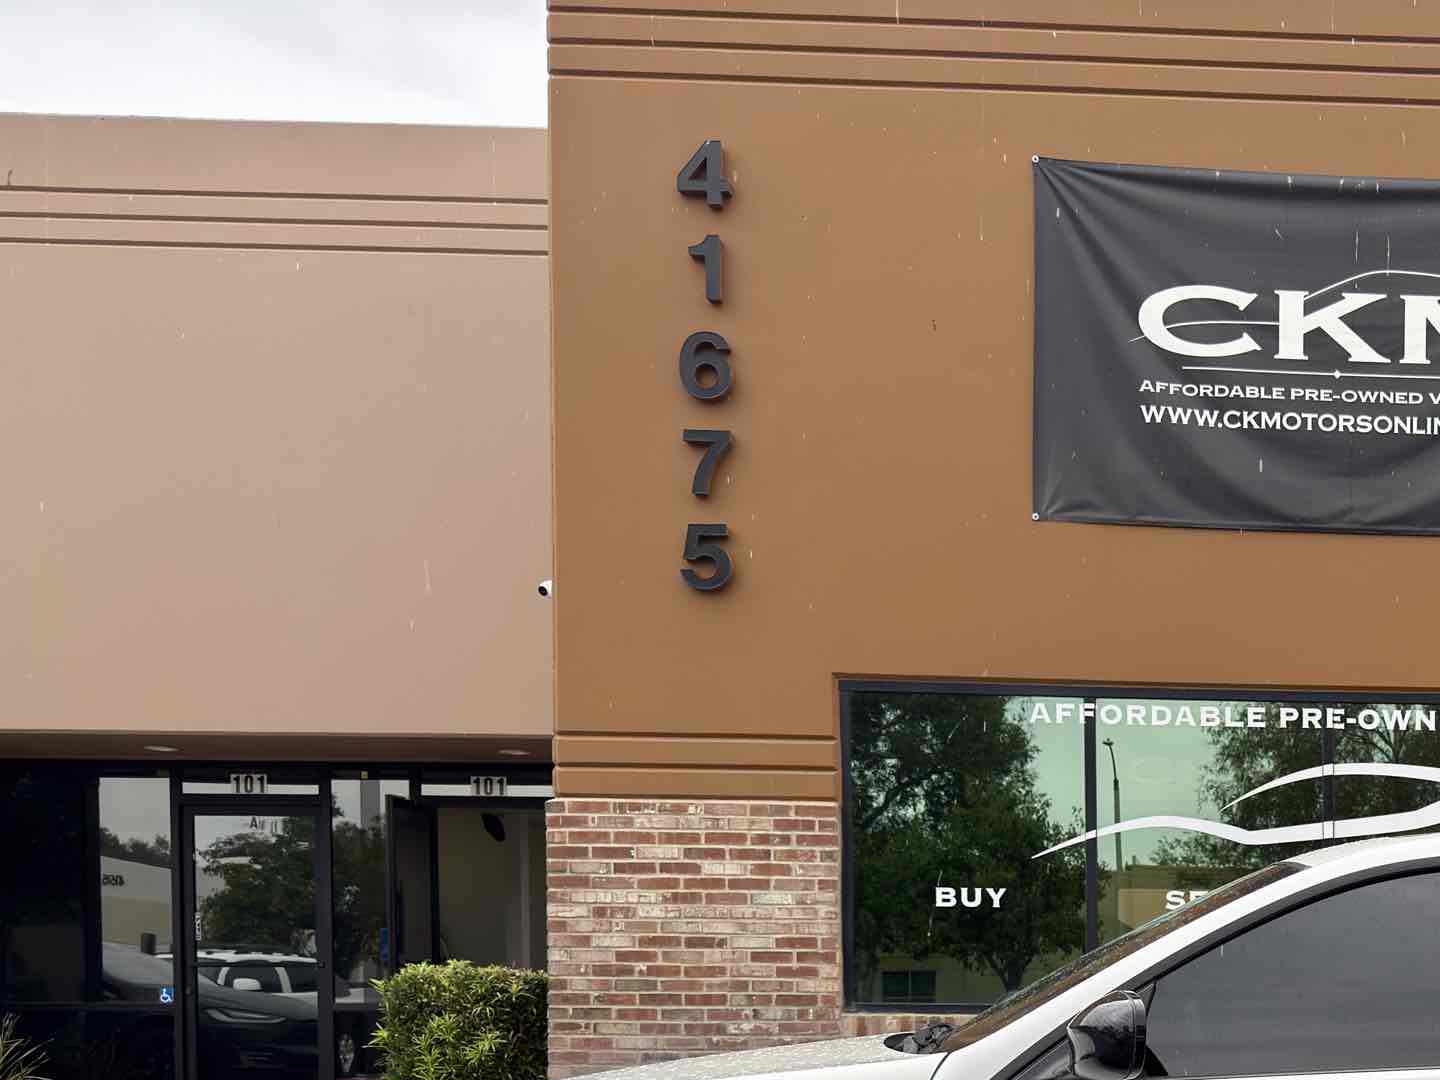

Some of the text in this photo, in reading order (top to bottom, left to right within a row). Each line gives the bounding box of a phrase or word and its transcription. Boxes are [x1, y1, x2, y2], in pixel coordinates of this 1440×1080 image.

[676, 139, 734, 592] 41675
[1138, 379, 1286, 400] AFFORDABLE
[1290, 387, 1424, 405] PRE-OWNED
[1028, 702, 1267, 728] AFFORDABLE
[233, 775, 265, 794] 101
[473, 777, 504, 795] 101
[935, 887, 1007, 908] BUY
